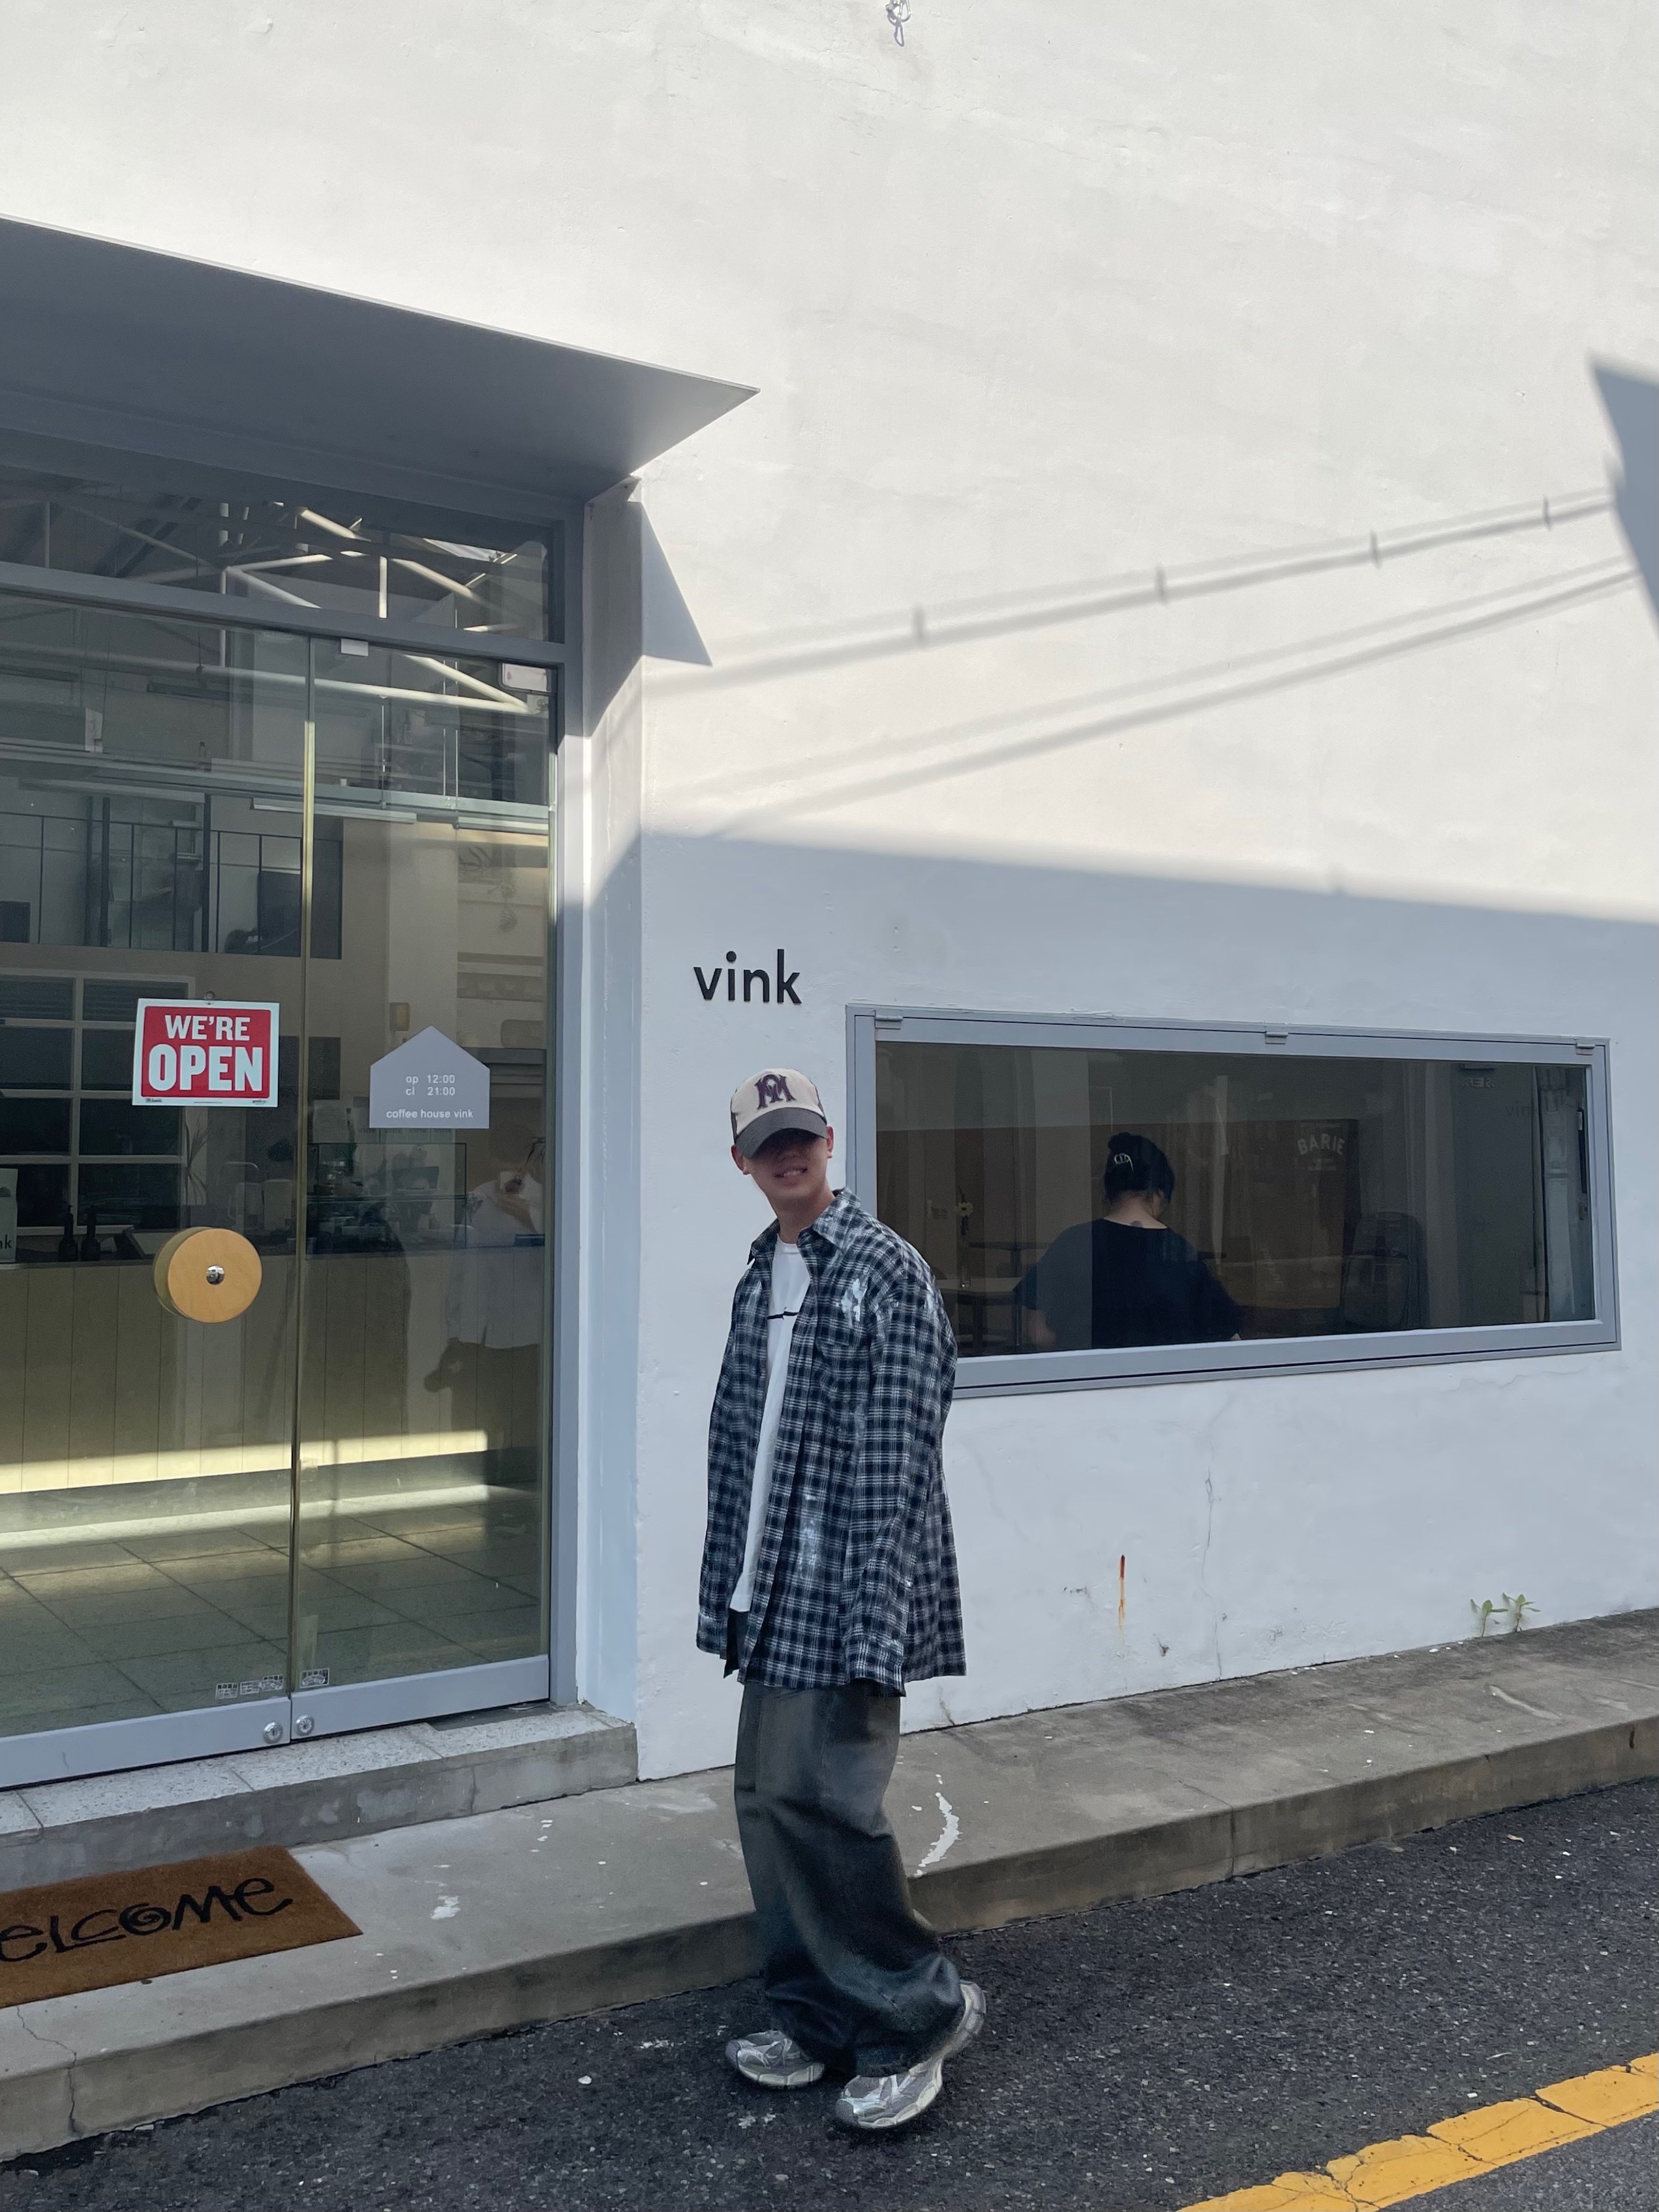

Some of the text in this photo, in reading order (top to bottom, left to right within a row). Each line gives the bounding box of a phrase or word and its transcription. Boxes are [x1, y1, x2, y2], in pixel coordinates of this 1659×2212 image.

[693, 948, 802, 1004] vink
[165, 1014, 251, 1041] WE'RE
[148, 1044, 263, 1091] OPEN
[405, 1074, 455, 1085] op 12:00
[405, 1086, 455, 1096] cl 21:00
[386, 1109, 474, 1118] coffee house vink
